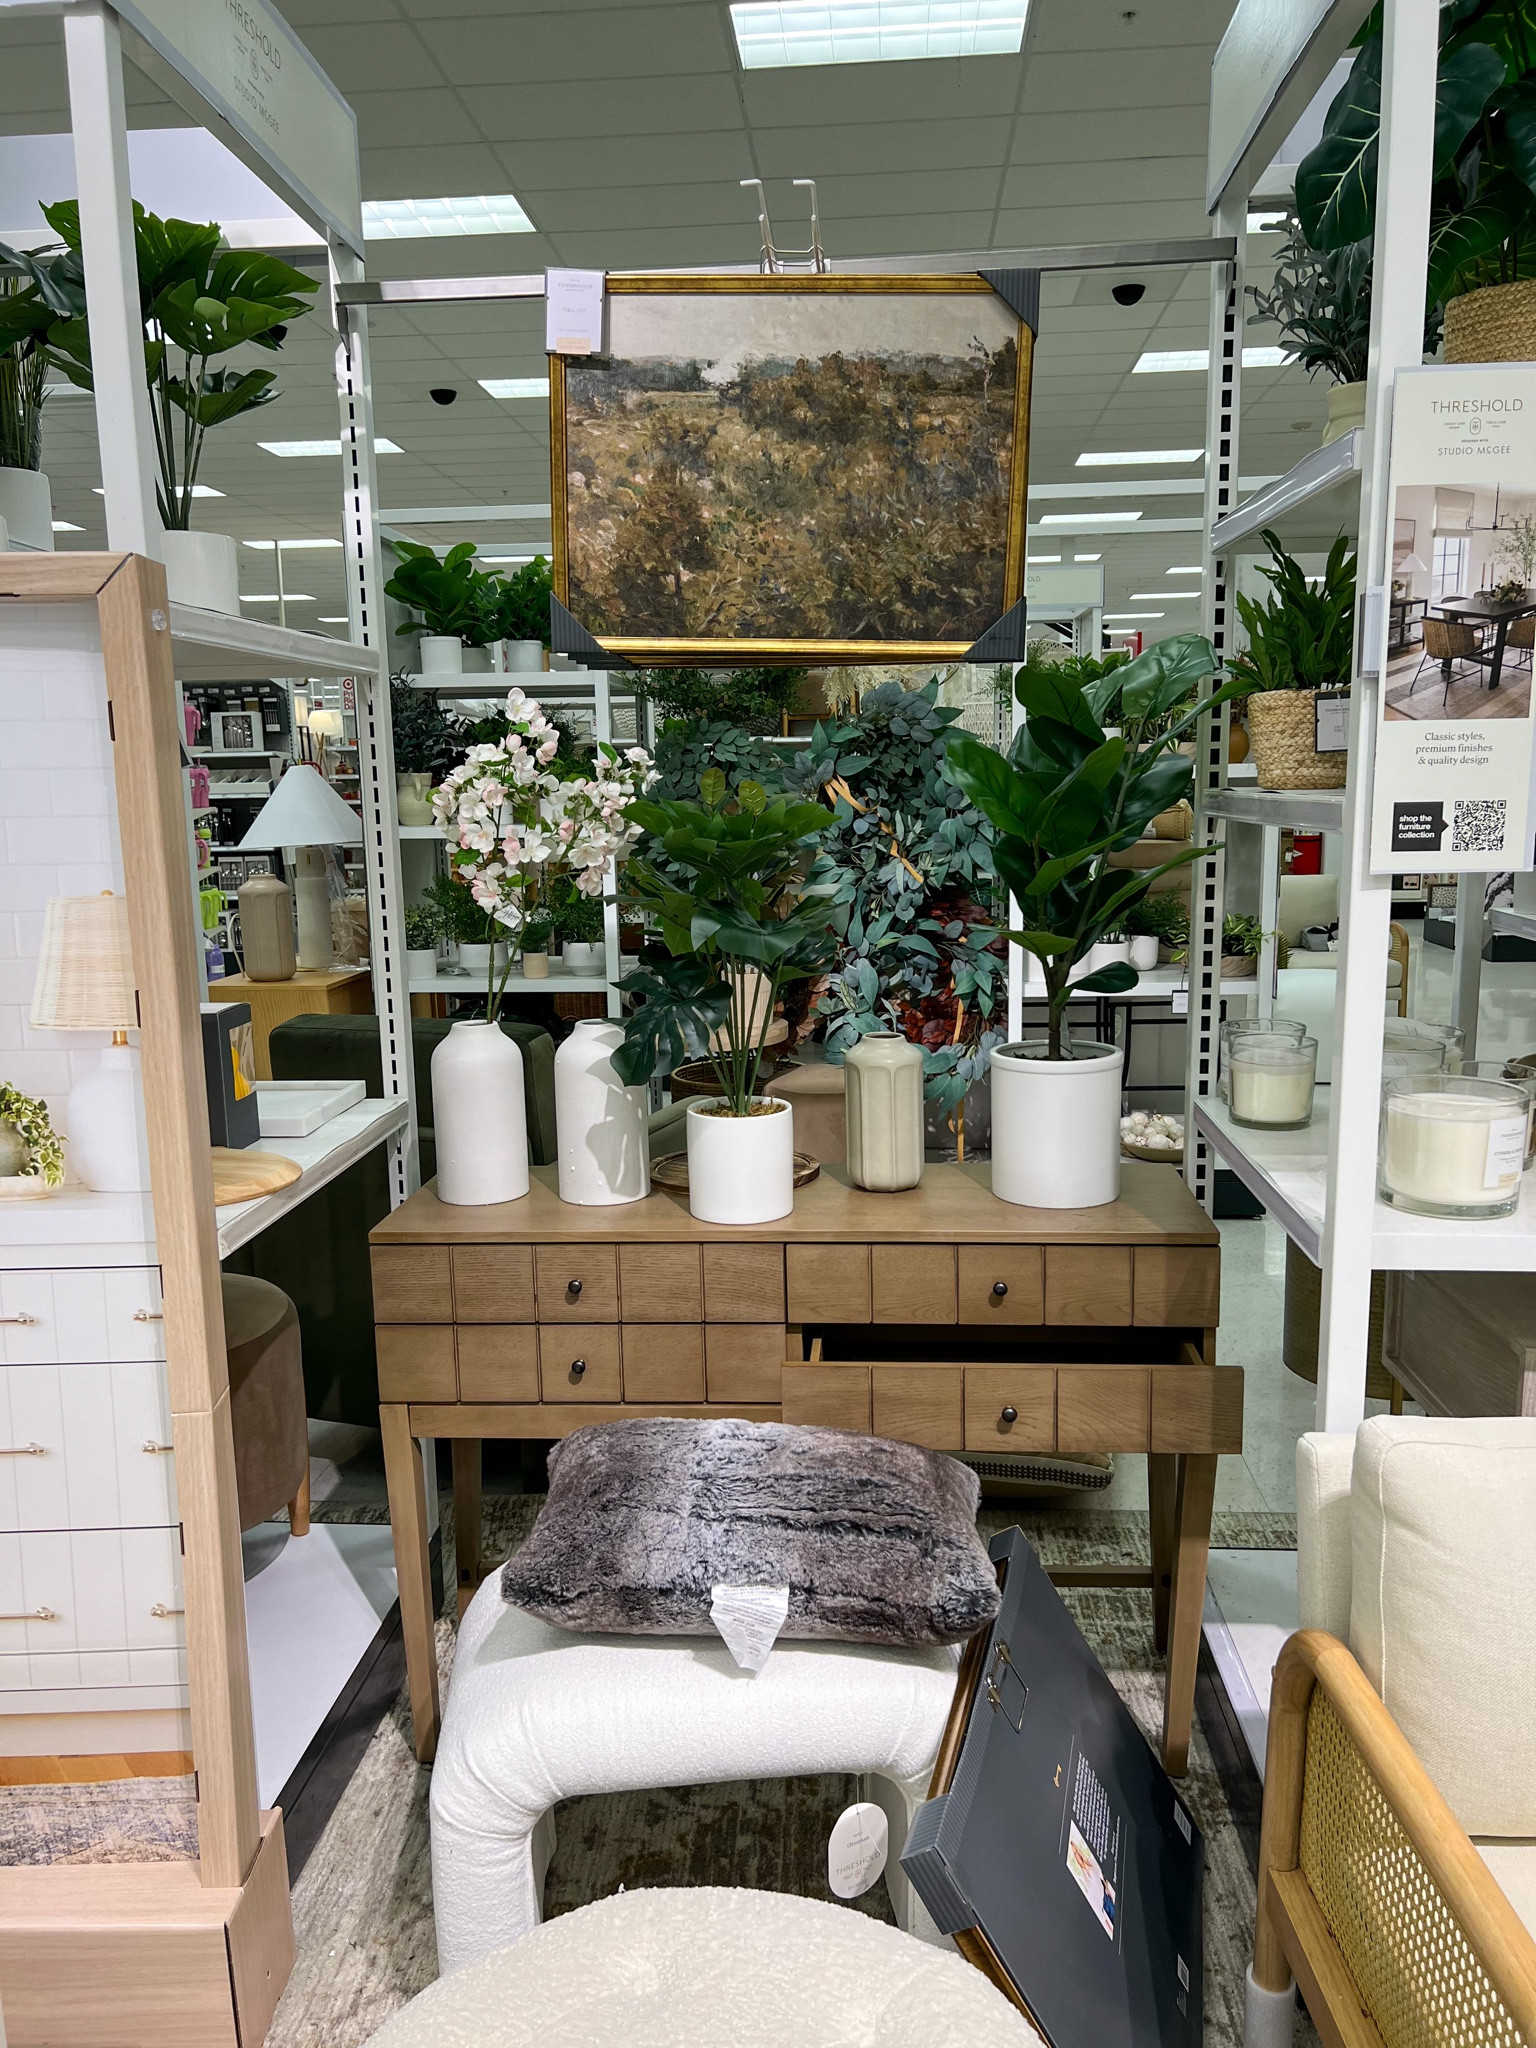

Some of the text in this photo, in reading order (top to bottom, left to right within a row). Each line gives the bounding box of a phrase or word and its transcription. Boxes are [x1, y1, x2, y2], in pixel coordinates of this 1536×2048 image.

[1431, 398, 1523, 414] THRESHOLD
[1438, 446, 1473, 456] STUDIO
[1424, 731, 1486, 742] Classic styles,
[1416, 743, 1493, 755] premium finishes
[1417, 755, 1489, 767] & quality design
[1399, 814, 1433, 823] shop the
[1398, 822, 1431, 831] furniture
[1398, 830, 1435, 839] collection
[836, 1850, 881, 1876] THRESHOLD
